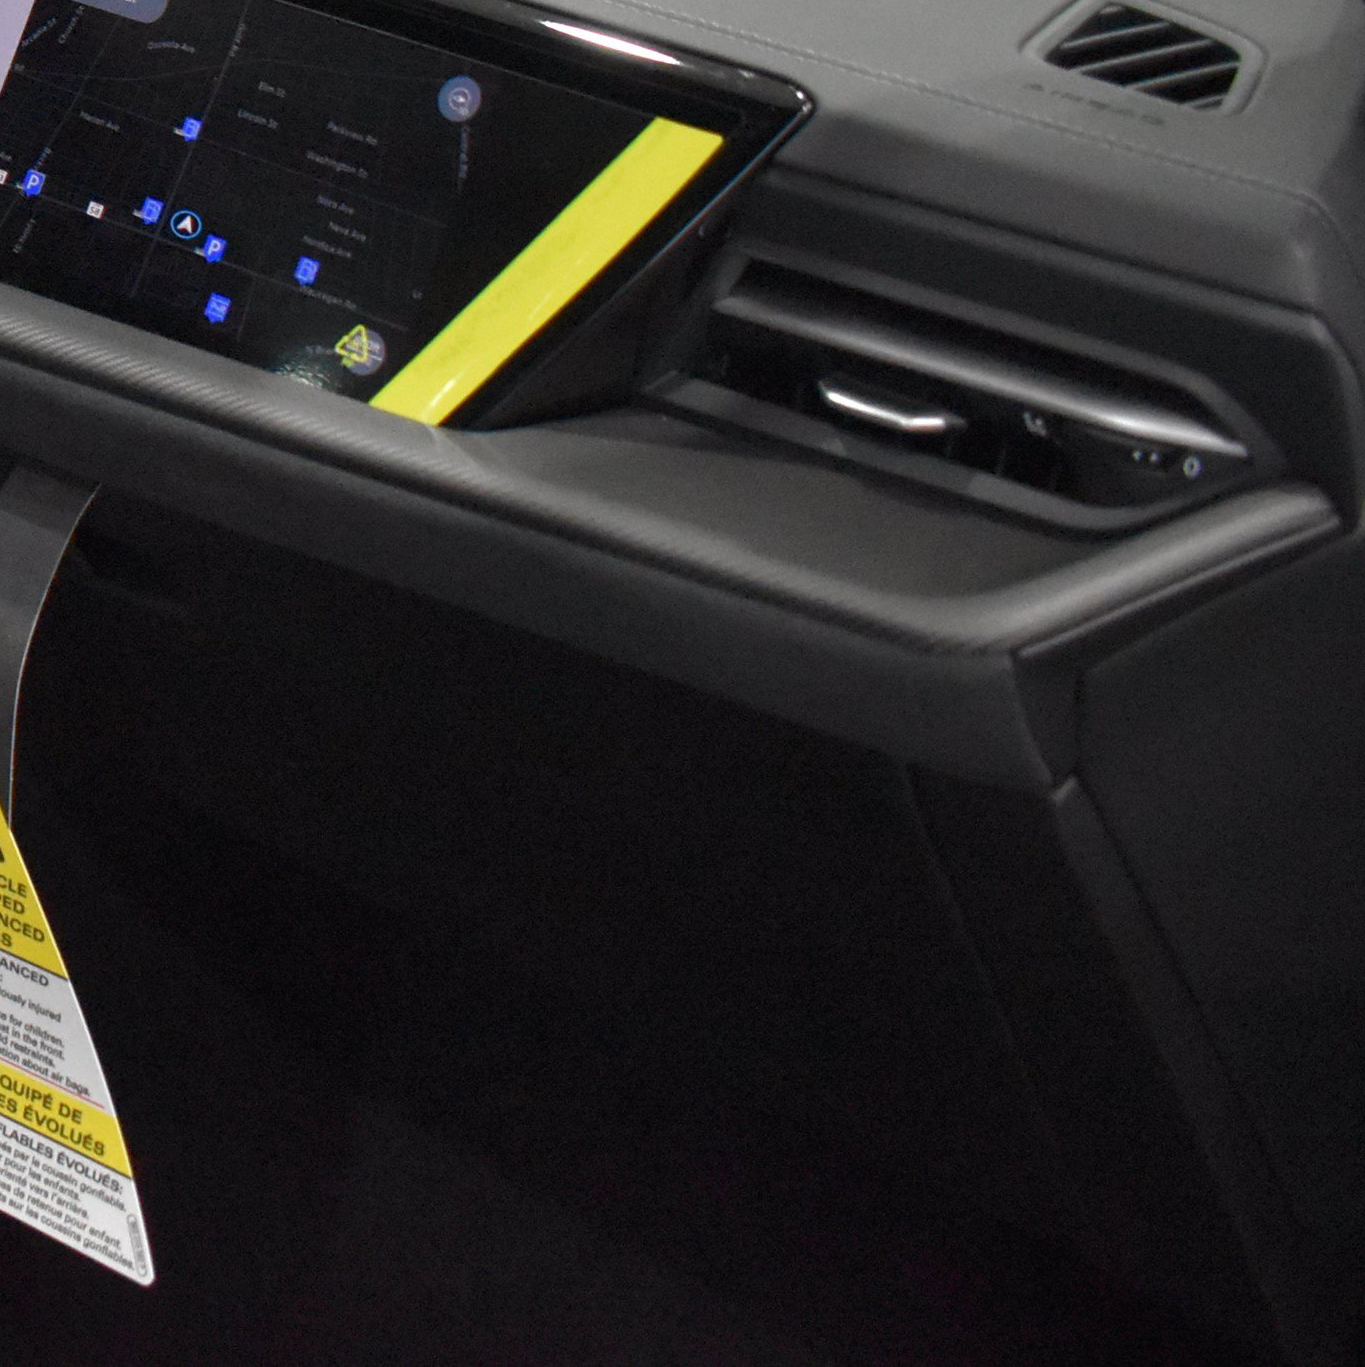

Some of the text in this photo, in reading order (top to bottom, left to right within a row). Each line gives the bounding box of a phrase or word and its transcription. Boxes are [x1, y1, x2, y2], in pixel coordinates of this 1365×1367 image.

[27, 999, 61, 1023] injured
[23, 1023, 64, 1048] children.
[9, 1040, 55, 1068] restraints.
[39, 1040, 64, 1060] front.
[21, 1058, 49, 1077] about
[64, 1076, 90, 1097] bags.
[57, 1101, 82, 1124] DE
[22, 1103, 104, 1156] ÉVOLUÉS
[55, 1150, 123, 1194] ÉVOLUÉS:
